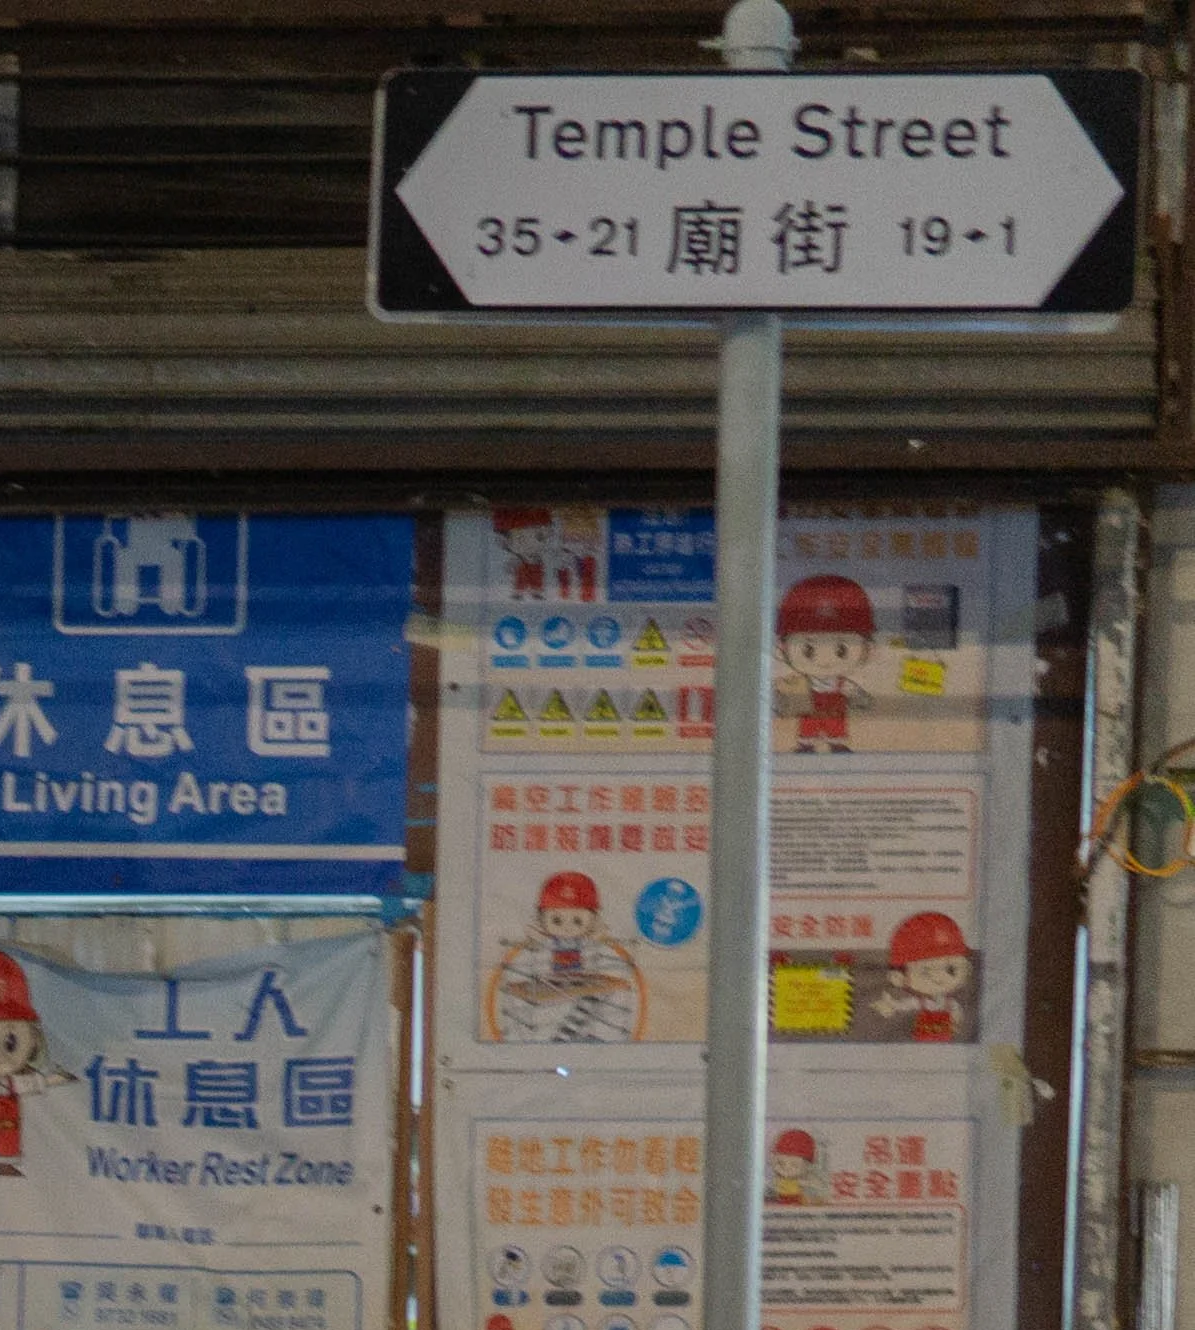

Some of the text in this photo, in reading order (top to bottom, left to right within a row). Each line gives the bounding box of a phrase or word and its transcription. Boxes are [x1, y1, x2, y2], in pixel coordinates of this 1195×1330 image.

[513, 104, 1012, 170] Temple Street
[476, 200, 1018, 276] 35 21 廟街 19 1
[2, 772, 288, 826] Living Area
[85, 1055, 356, 1130] 休息區
[87, 1146, 356, 1187] Worker Rest Zone
